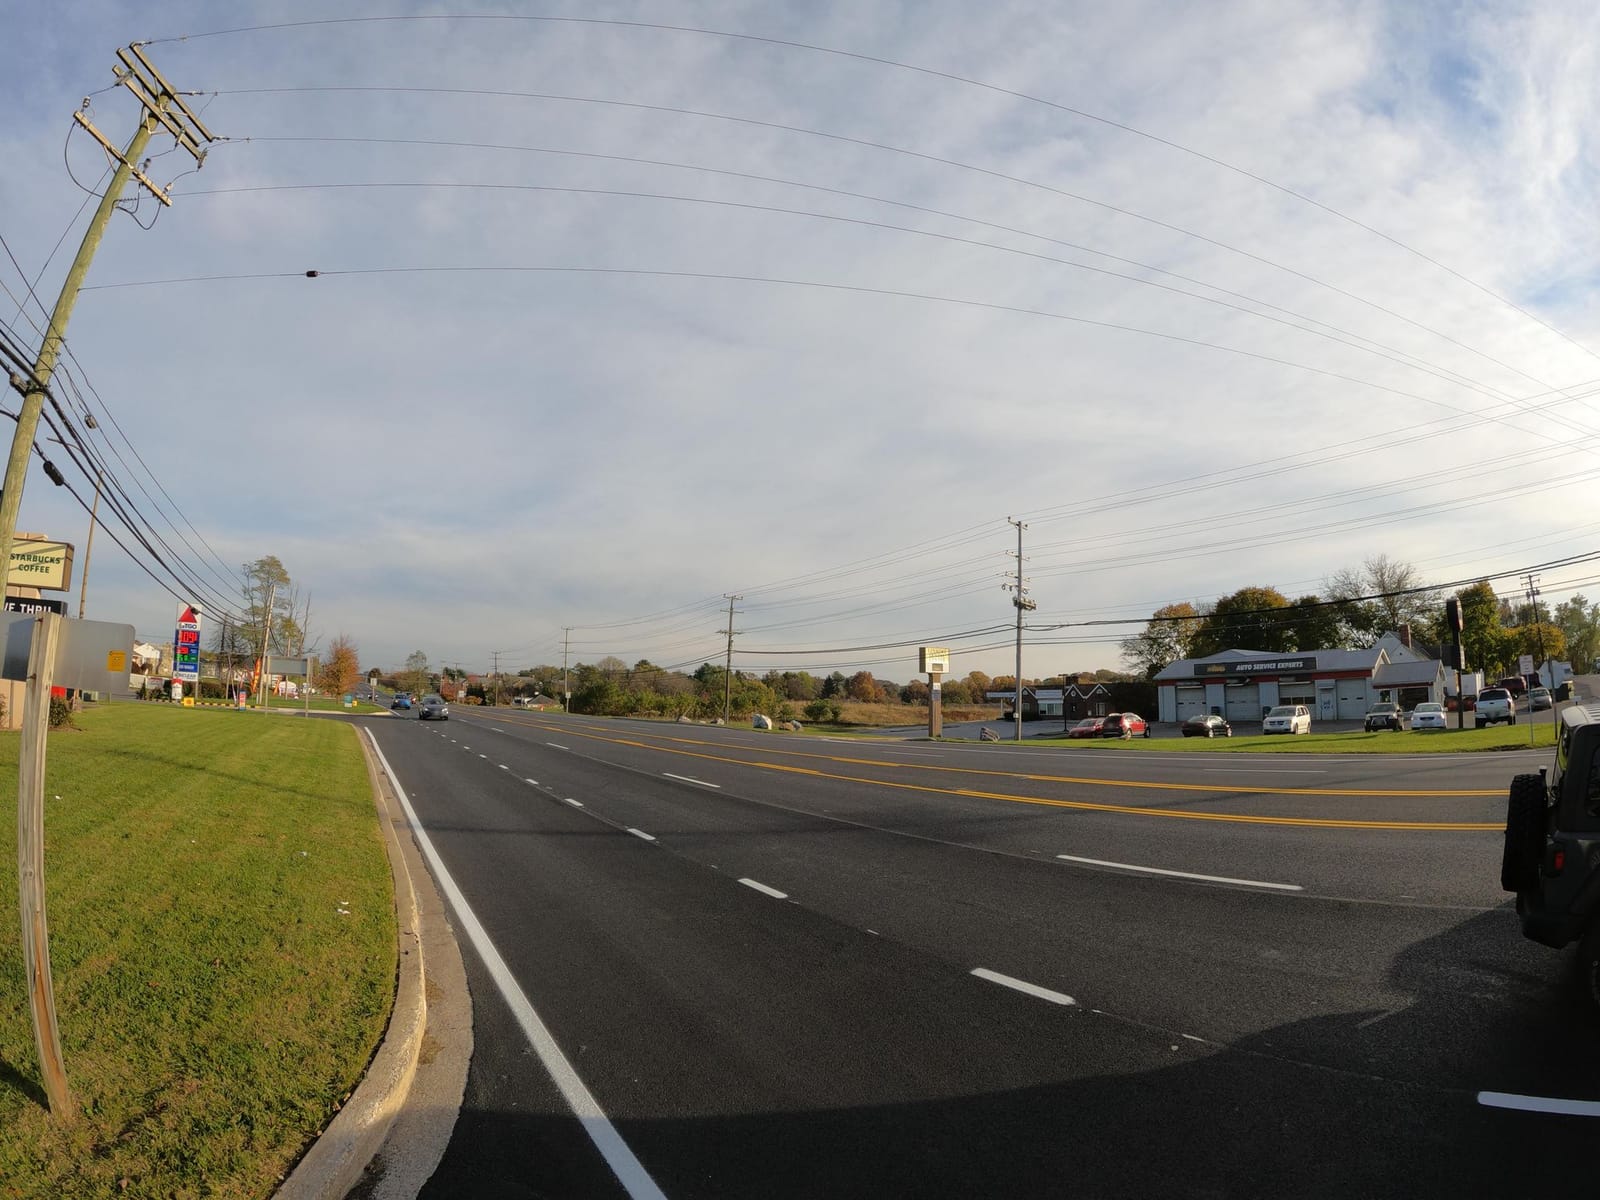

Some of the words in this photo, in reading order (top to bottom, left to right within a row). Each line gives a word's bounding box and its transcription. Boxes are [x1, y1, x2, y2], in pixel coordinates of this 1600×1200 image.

[9, 553, 61, 564] STARBUCKS
[18, 564, 50, 573] COFFEE
[20, 603, 51, 615] THRU
[1277, 661, 1303, 669] EXPERTS
